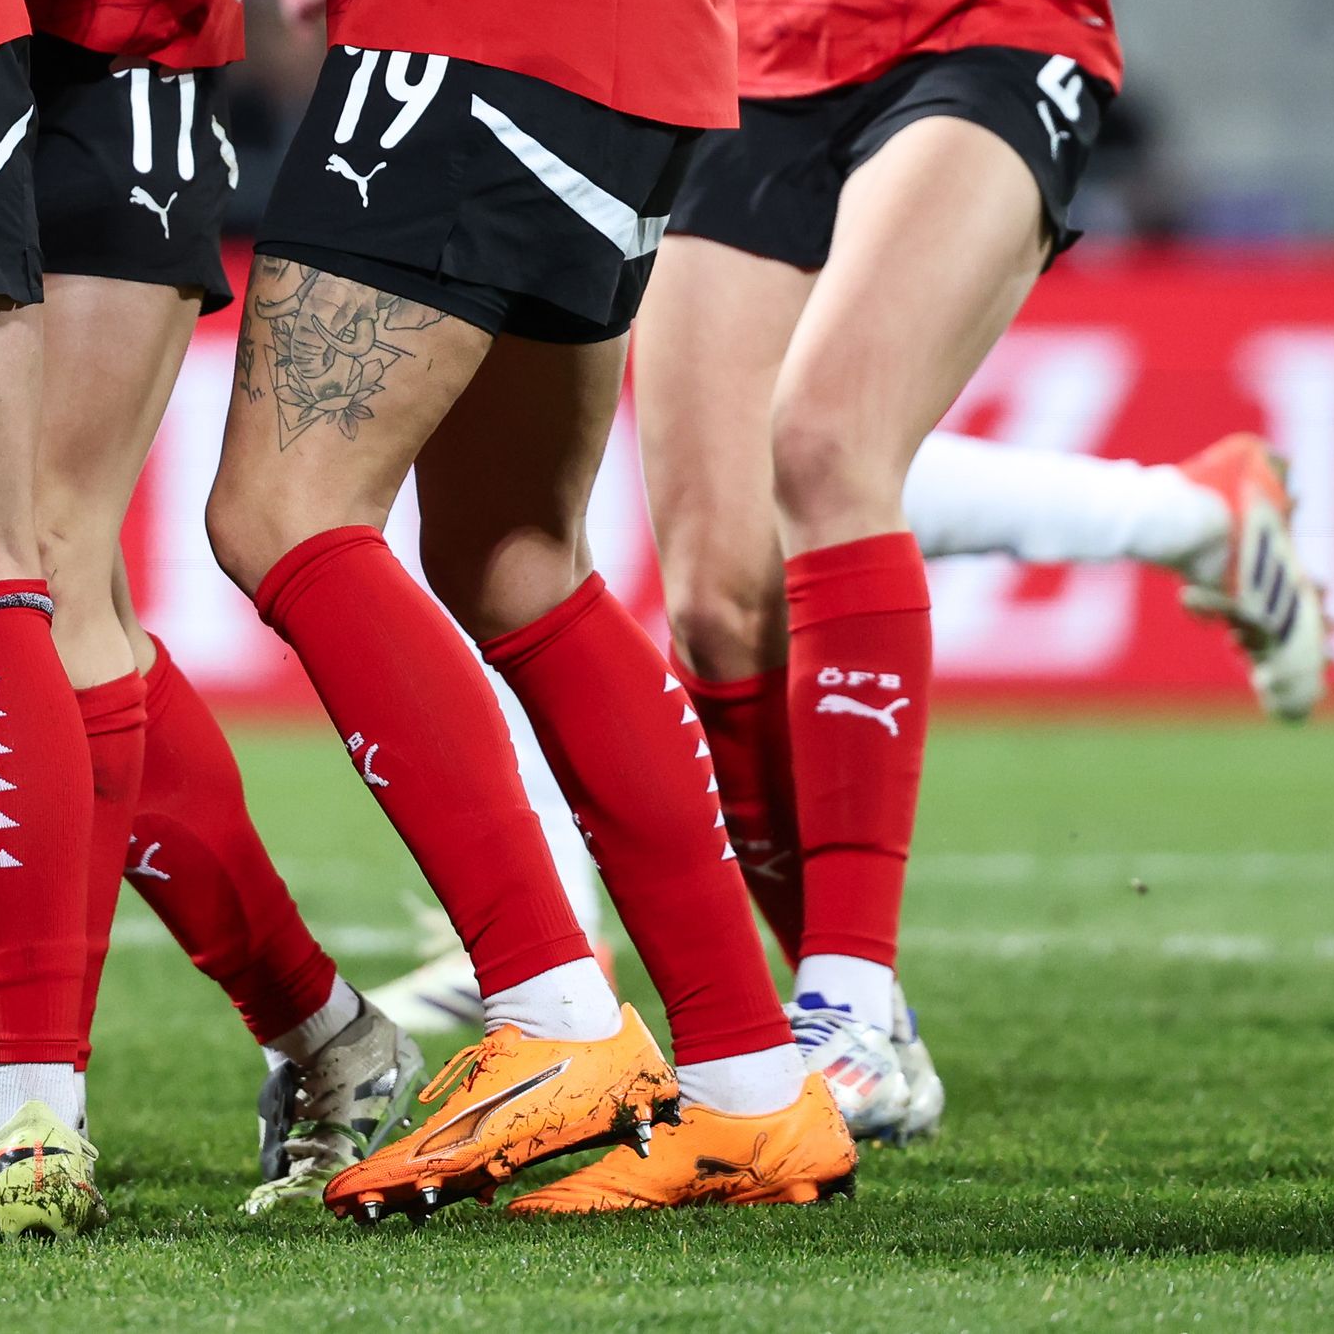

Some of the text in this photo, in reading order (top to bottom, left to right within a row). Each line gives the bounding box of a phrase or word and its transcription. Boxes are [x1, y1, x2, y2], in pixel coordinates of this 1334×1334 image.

[112, 68, 196, 182] 11
[334, 45, 450, 150] 19
[1036, 53, 1083, 122] 4
[817, 666, 901, 690] ÖFB
